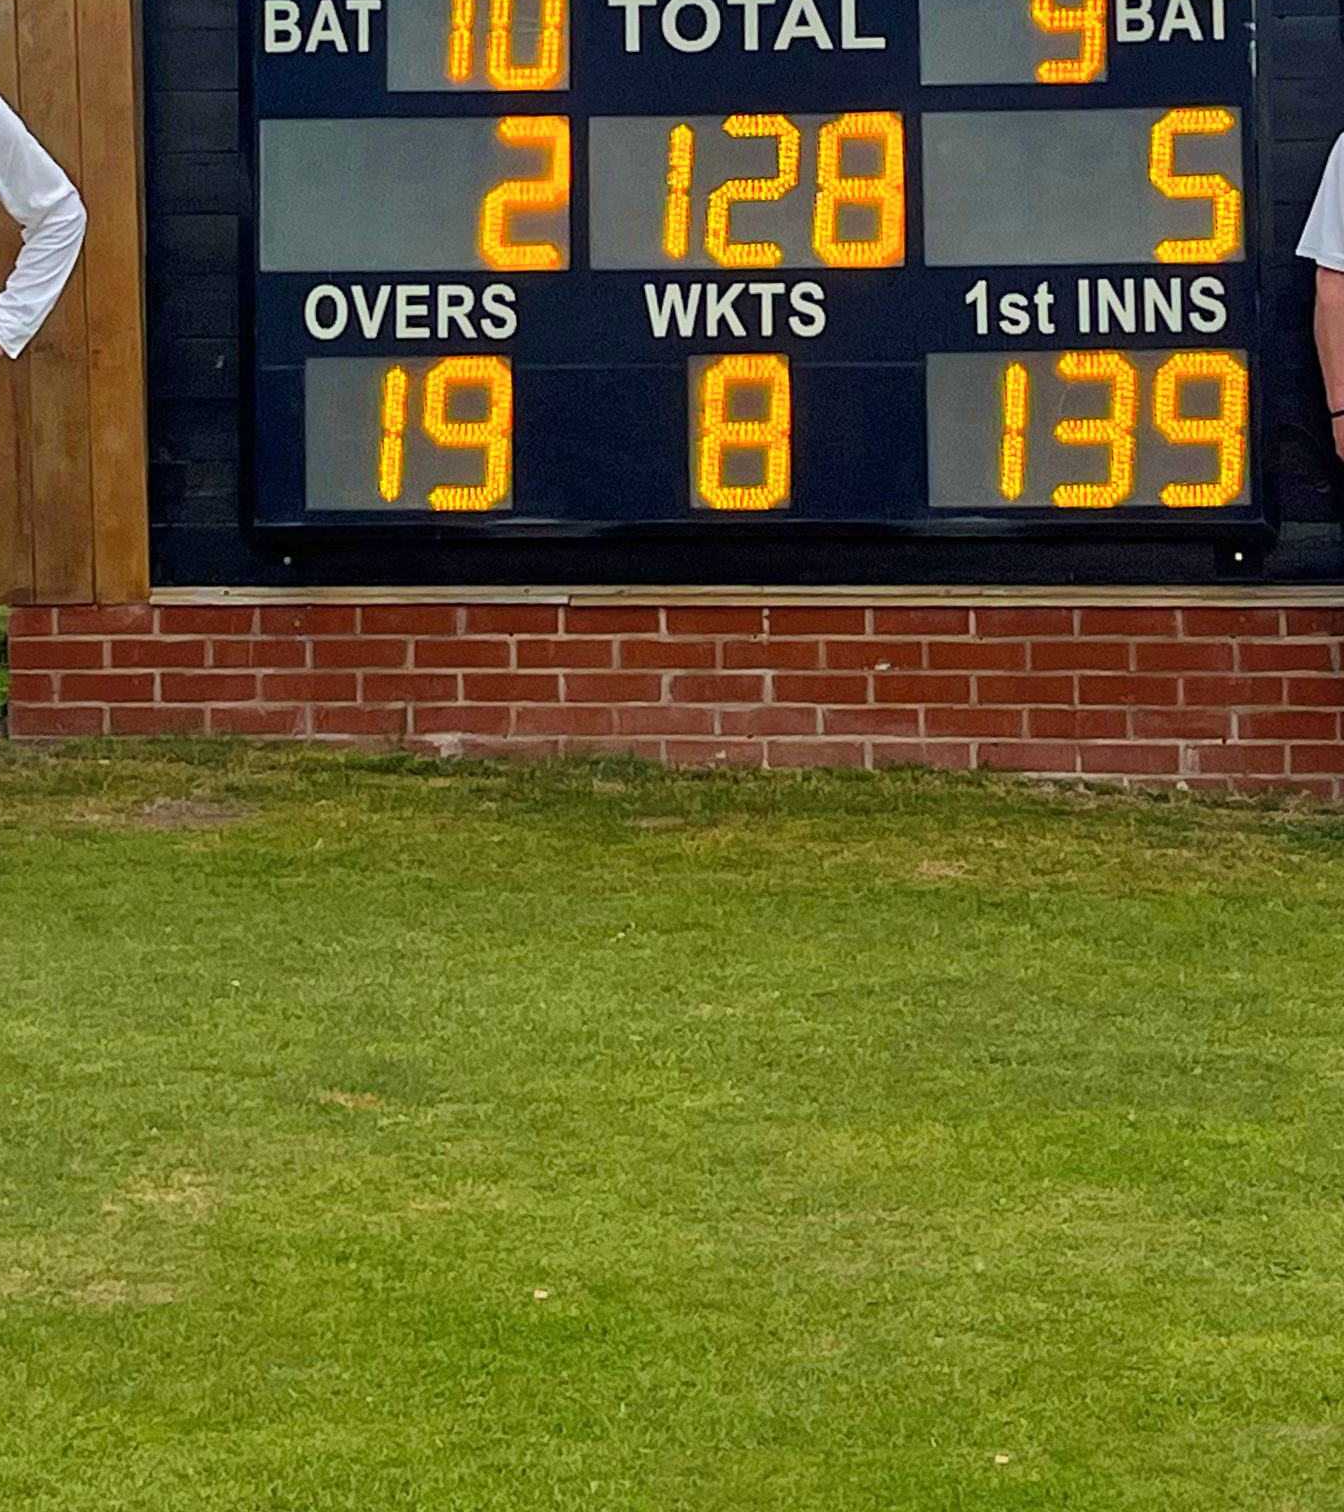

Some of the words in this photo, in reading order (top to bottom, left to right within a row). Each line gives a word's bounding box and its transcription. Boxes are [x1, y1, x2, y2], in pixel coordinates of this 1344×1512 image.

[264, 0, 381, 54] BAT
[478, 114, 572, 272] 2
[662, 111, 906, 269] 128
[1148, 107, 1241, 265] 5
[305, 284, 517, 340] OVERS
[644, 282, 826, 337] WKTS
[965, 280, 1055, 335] 1st
[1077, 276, 1227, 334] INNS
[378, 355, 514, 512] 19
[697, 353, 792, 511] 8
[1000, 350, 1249, 509] 139
